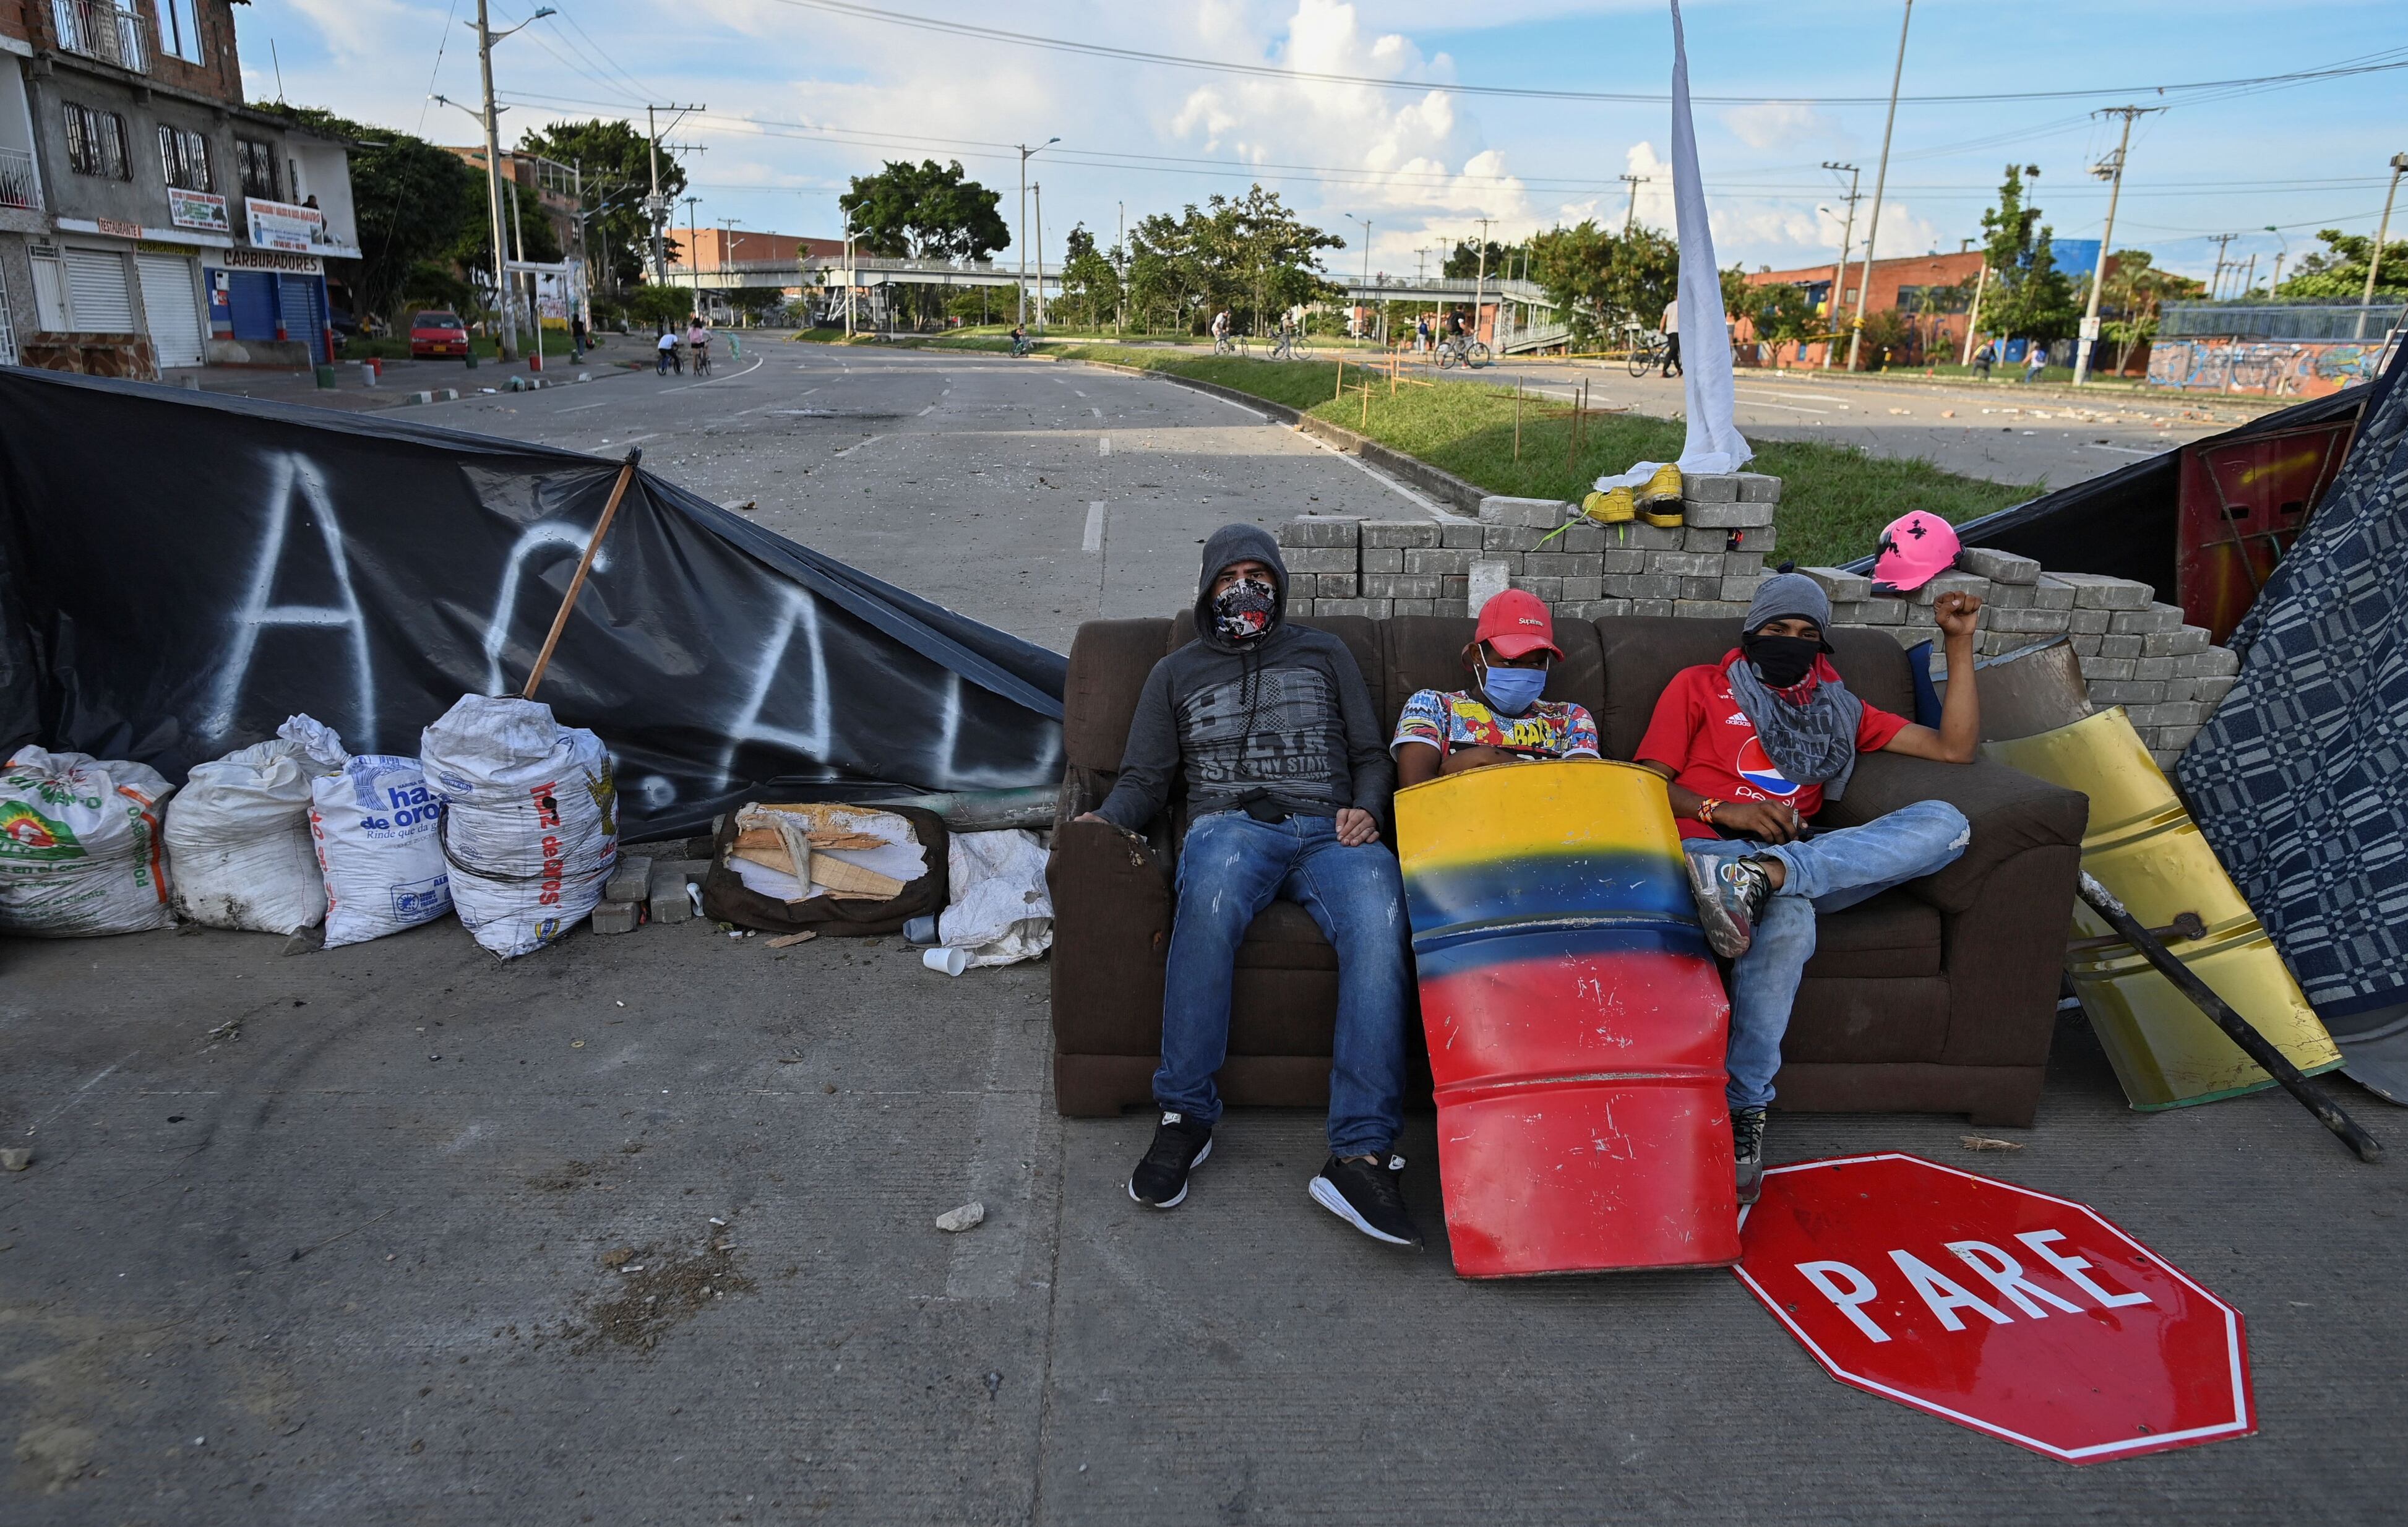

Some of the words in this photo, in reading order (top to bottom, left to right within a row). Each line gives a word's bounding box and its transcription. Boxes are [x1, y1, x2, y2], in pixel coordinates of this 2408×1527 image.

[100, 218, 137, 236] RESTAURANTE
[224, 249, 317, 272] CARBURADORES
[1725, 719, 1752, 727] adidas
[1261, 759, 1281, 773] NY
[1287, 756, 1330, 772] STATE
[387, 786, 437, 809] ha
[360, 816, 390, 830] de
[394, 803, 440, 827] oro
[367, 830, 395, 840] Rinde
[398, 827, 416, 839] que
[418, 823, 428, 833] da
[1794, 1228, 2152, 1343] PARE
